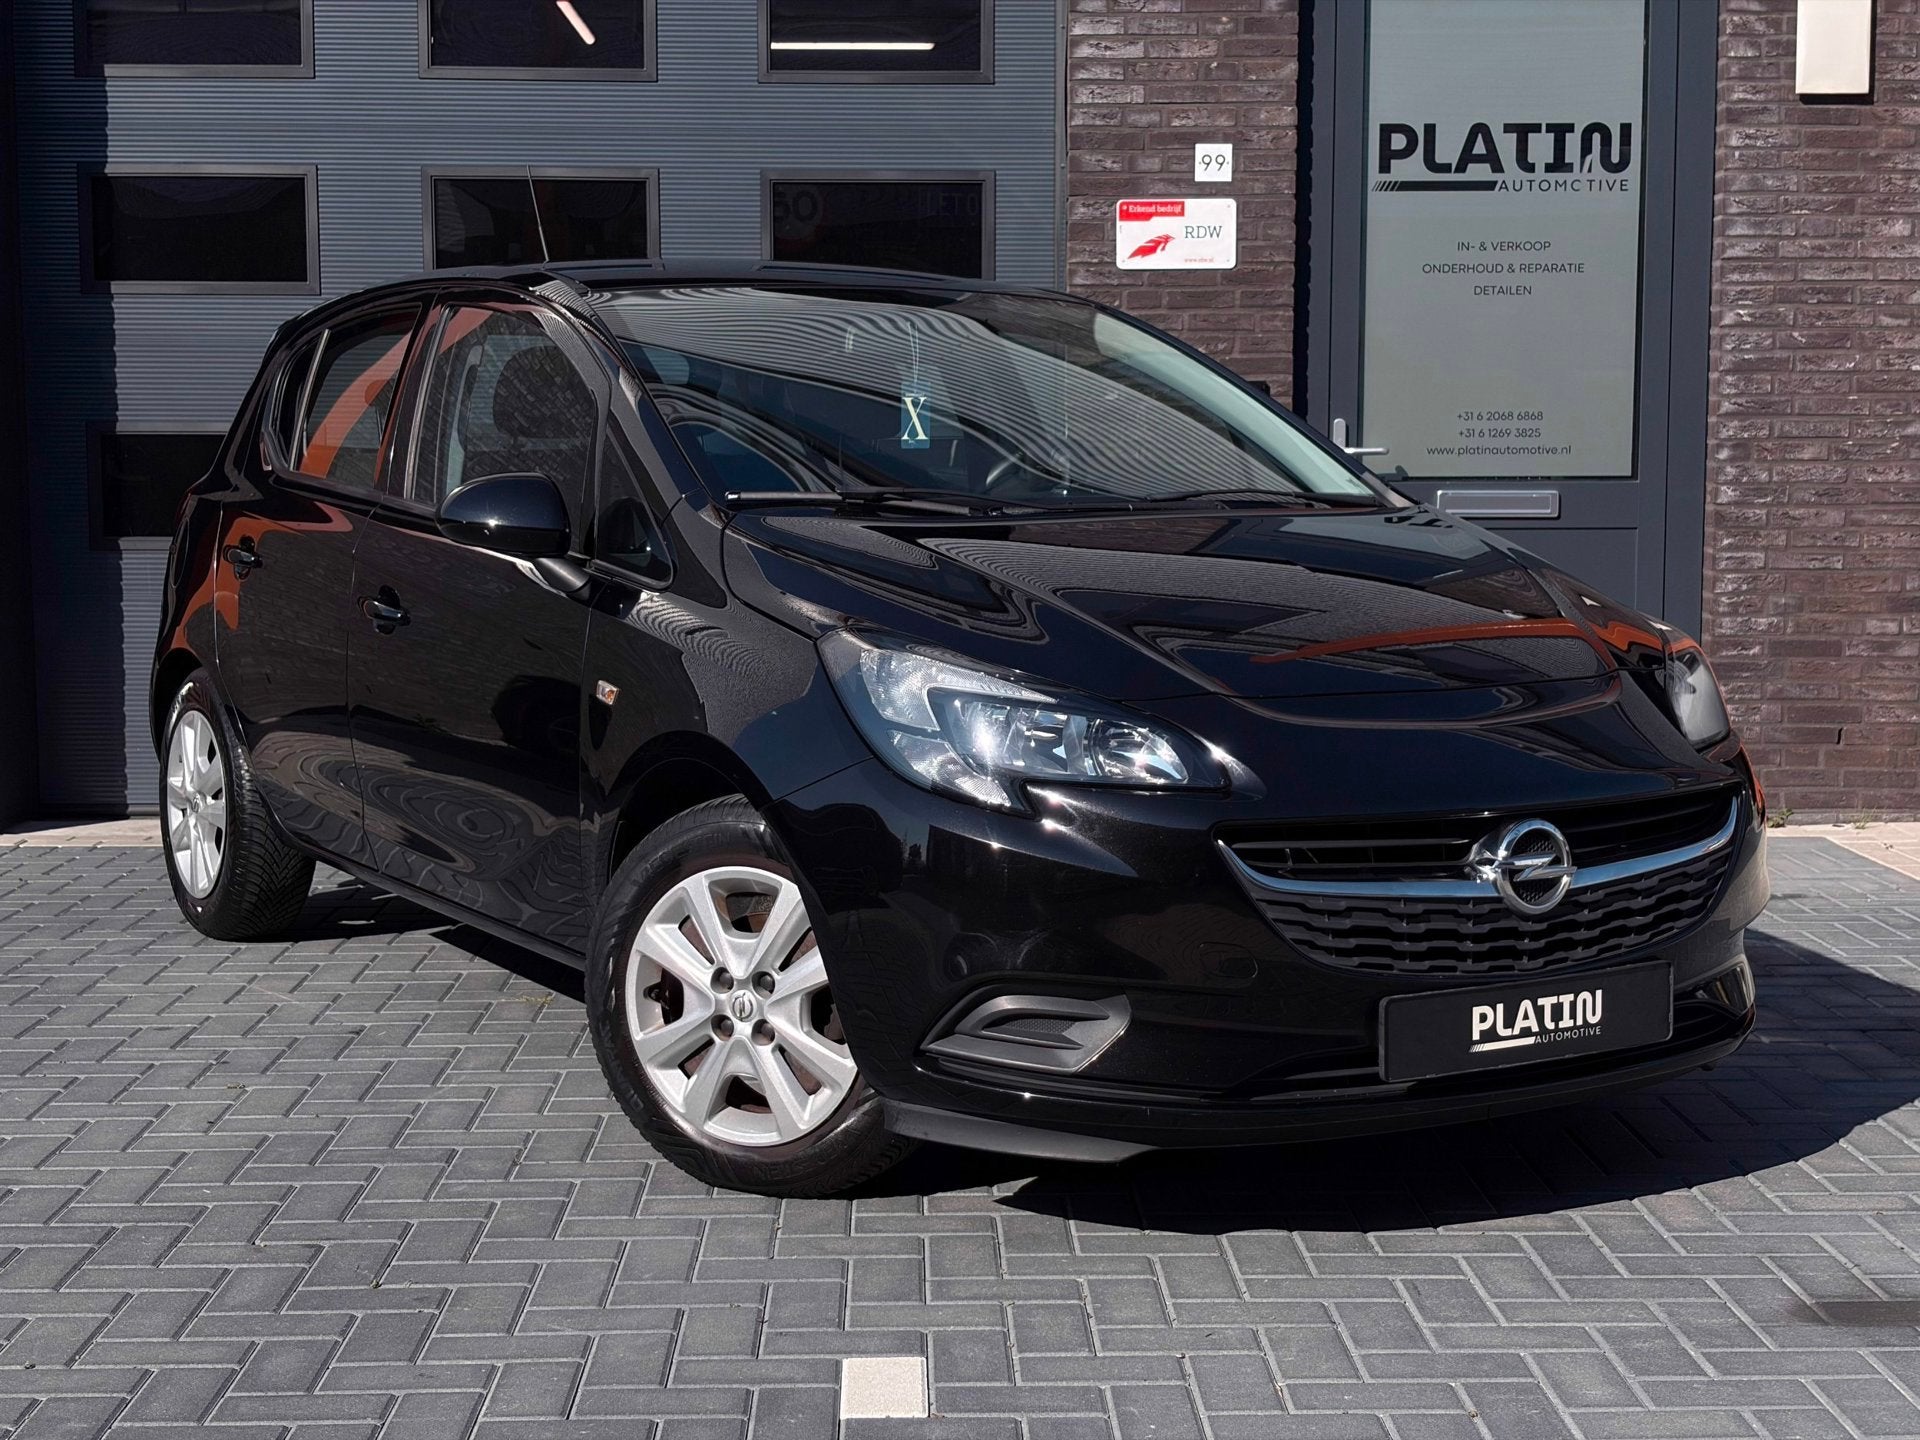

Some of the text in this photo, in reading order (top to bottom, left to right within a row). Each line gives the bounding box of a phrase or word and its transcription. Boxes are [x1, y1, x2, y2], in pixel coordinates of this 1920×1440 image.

[1378, 121, 1632, 174] PLATIN
[1201, 154, 1226, 171] 99
[1128, 205, 1182, 214] Erkend bedrijf
[1184, 225, 1222, 239] RDW
[1457, 241, 1551, 251] IN- & VERKOOP
[1422, 263, 1585, 274] ONDERHOUD & REPARATIE
[1473, 285, 1532, 296] DETAILEN
[1457, 411, 1544, 422] +31 6 2068 6868
[1458, 428, 1541, 438] +31 6 1269 3825
[1426, 445, 1571, 457] www.platinautomotive.nl
[1472, 989, 1603, 1041] PLATIN
[1535, 1025, 1602, 1044] AUTOMOTIVE
